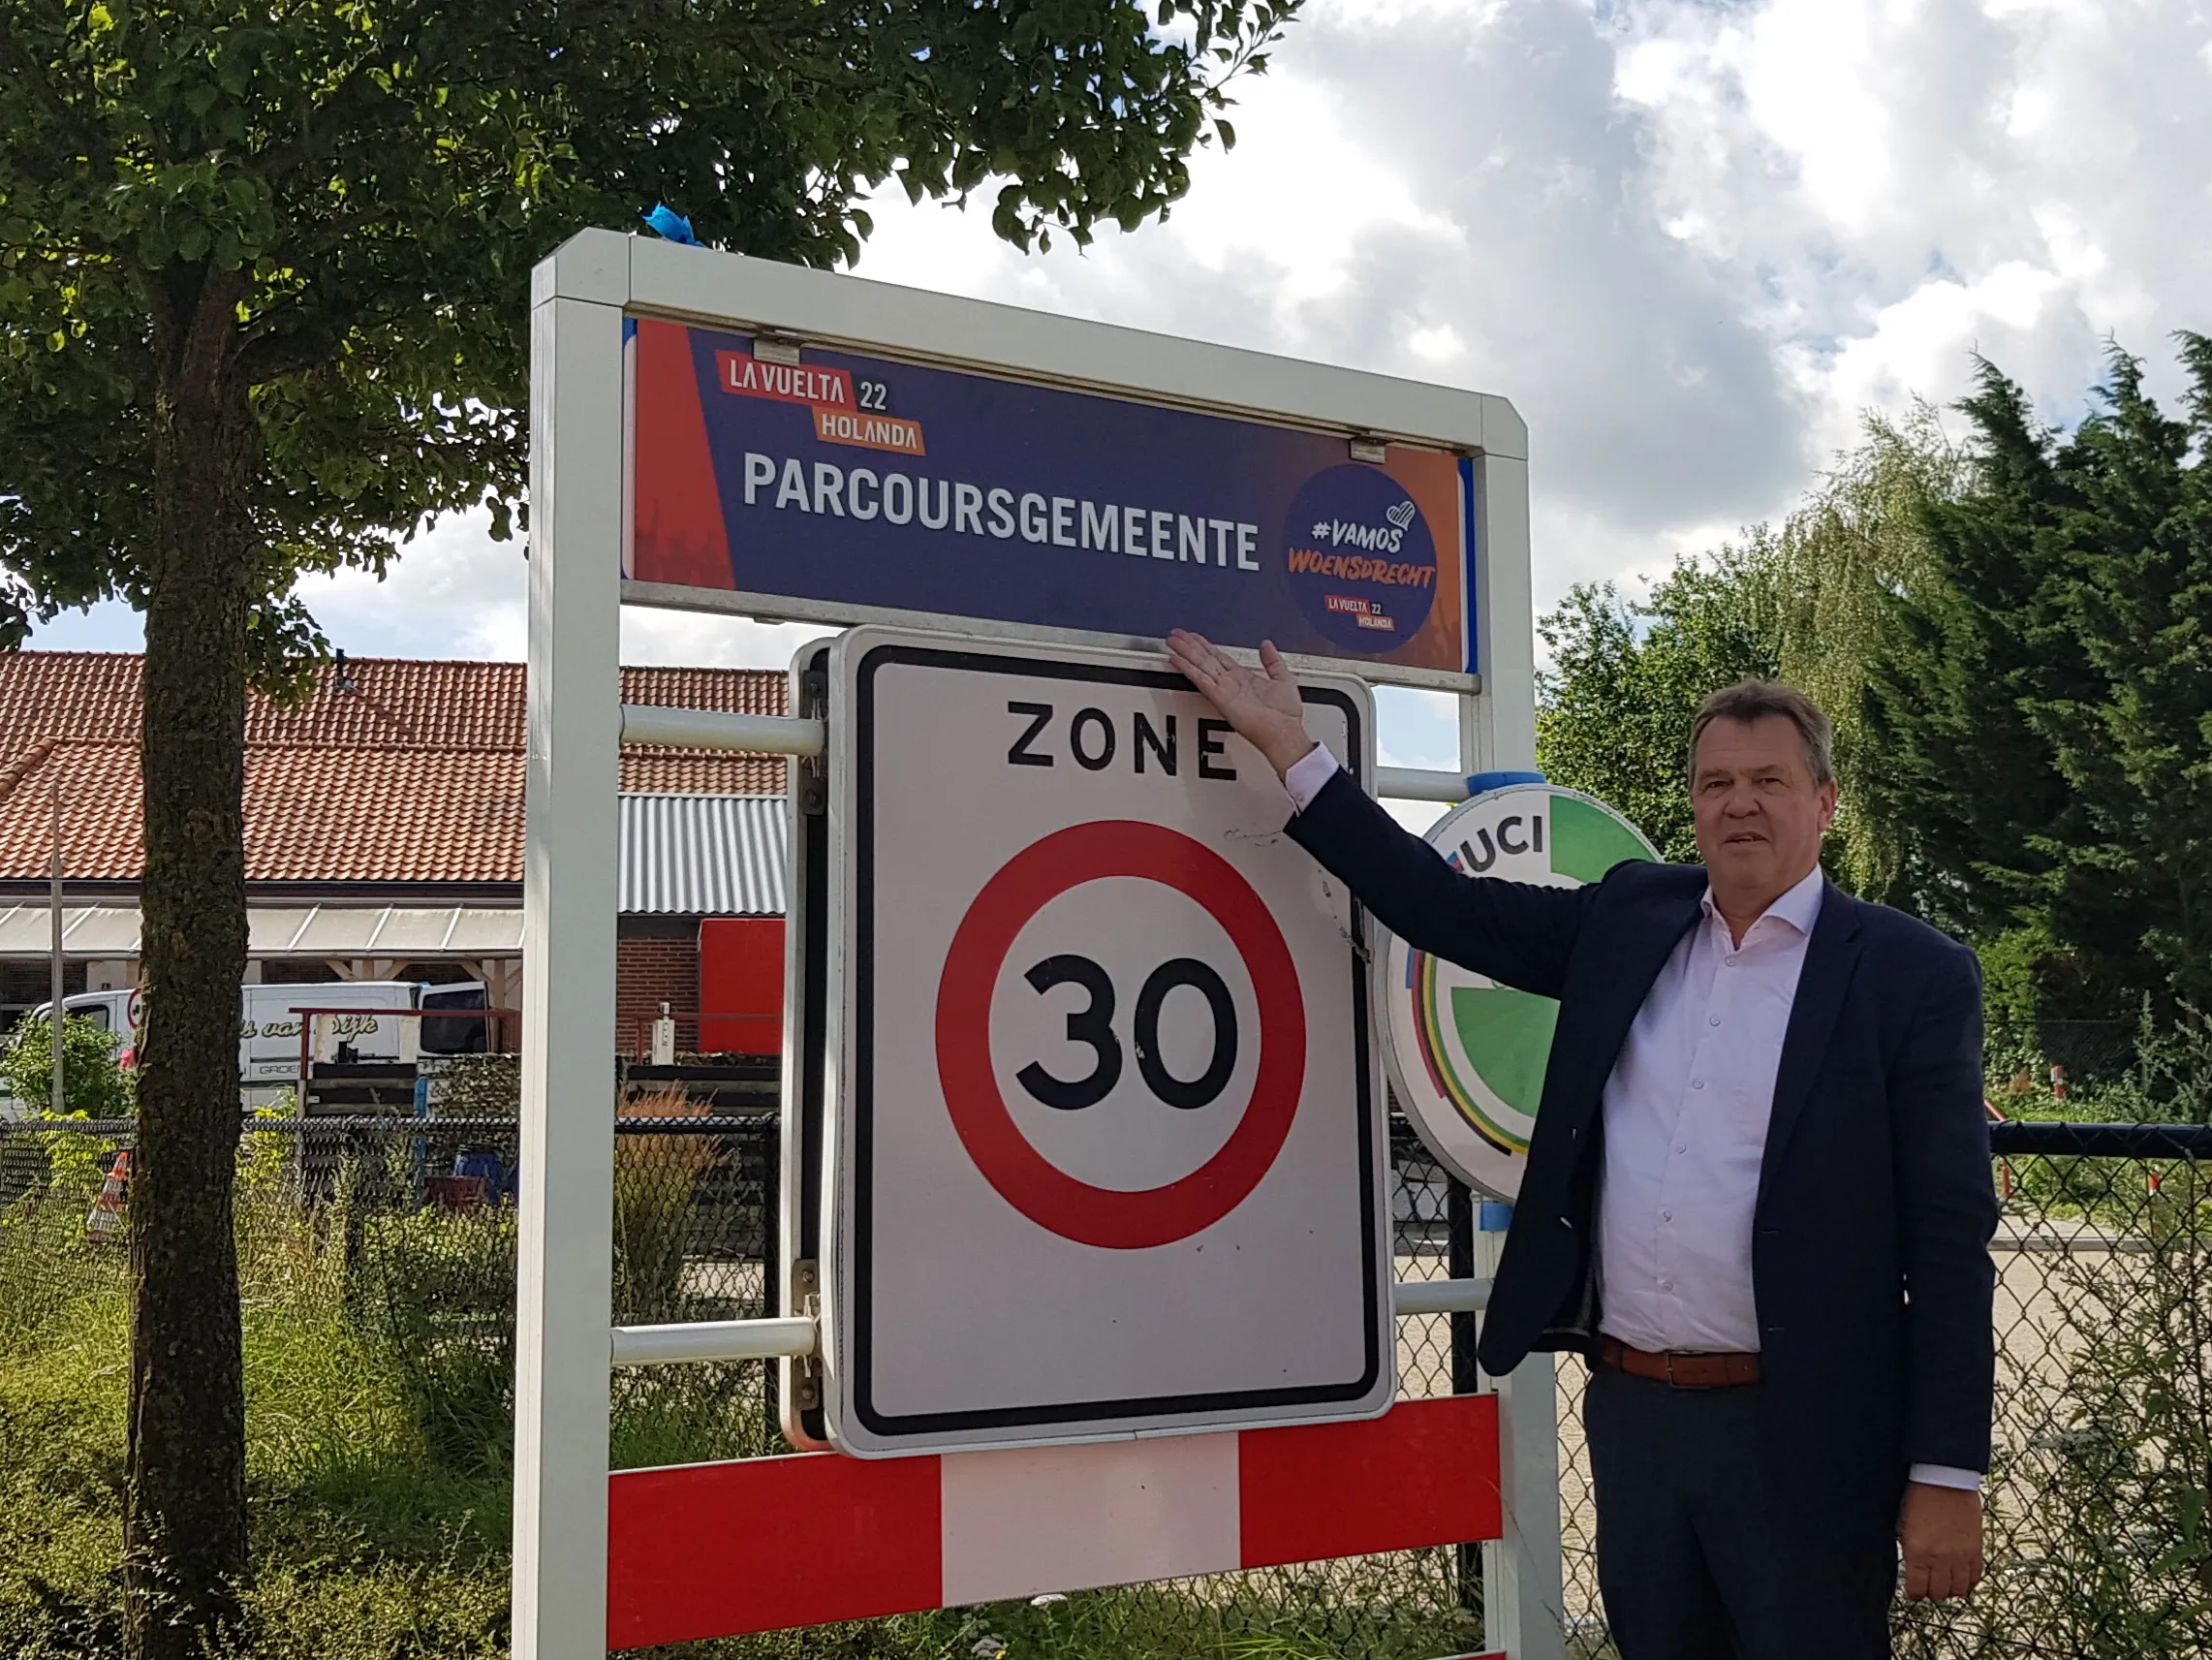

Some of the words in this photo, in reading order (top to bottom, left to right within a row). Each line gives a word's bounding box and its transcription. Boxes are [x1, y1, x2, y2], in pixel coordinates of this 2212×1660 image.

[731, 360, 758, 390] LA
[761, 364, 845, 404] VUELTA
[859, 381, 888, 411] 22
[822, 413, 918, 450] HOLANDA
[744, 452, 1261, 571] PARCOURSGEMEENTE
[1312, 518, 1404, 553] #VAMOS
[1289, 547, 1435, 588] WOENSDRECHT
[1339, 599, 1369, 613] VUELTA
[1371, 603, 1382, 614] 22
[1358, 616, 1392, 629] HOLANDA
[1007, 700, 1237, 781] ZONE
[1459, 815, 1542, 873] UCI
[1015, 954, 1238, 1111] 30
